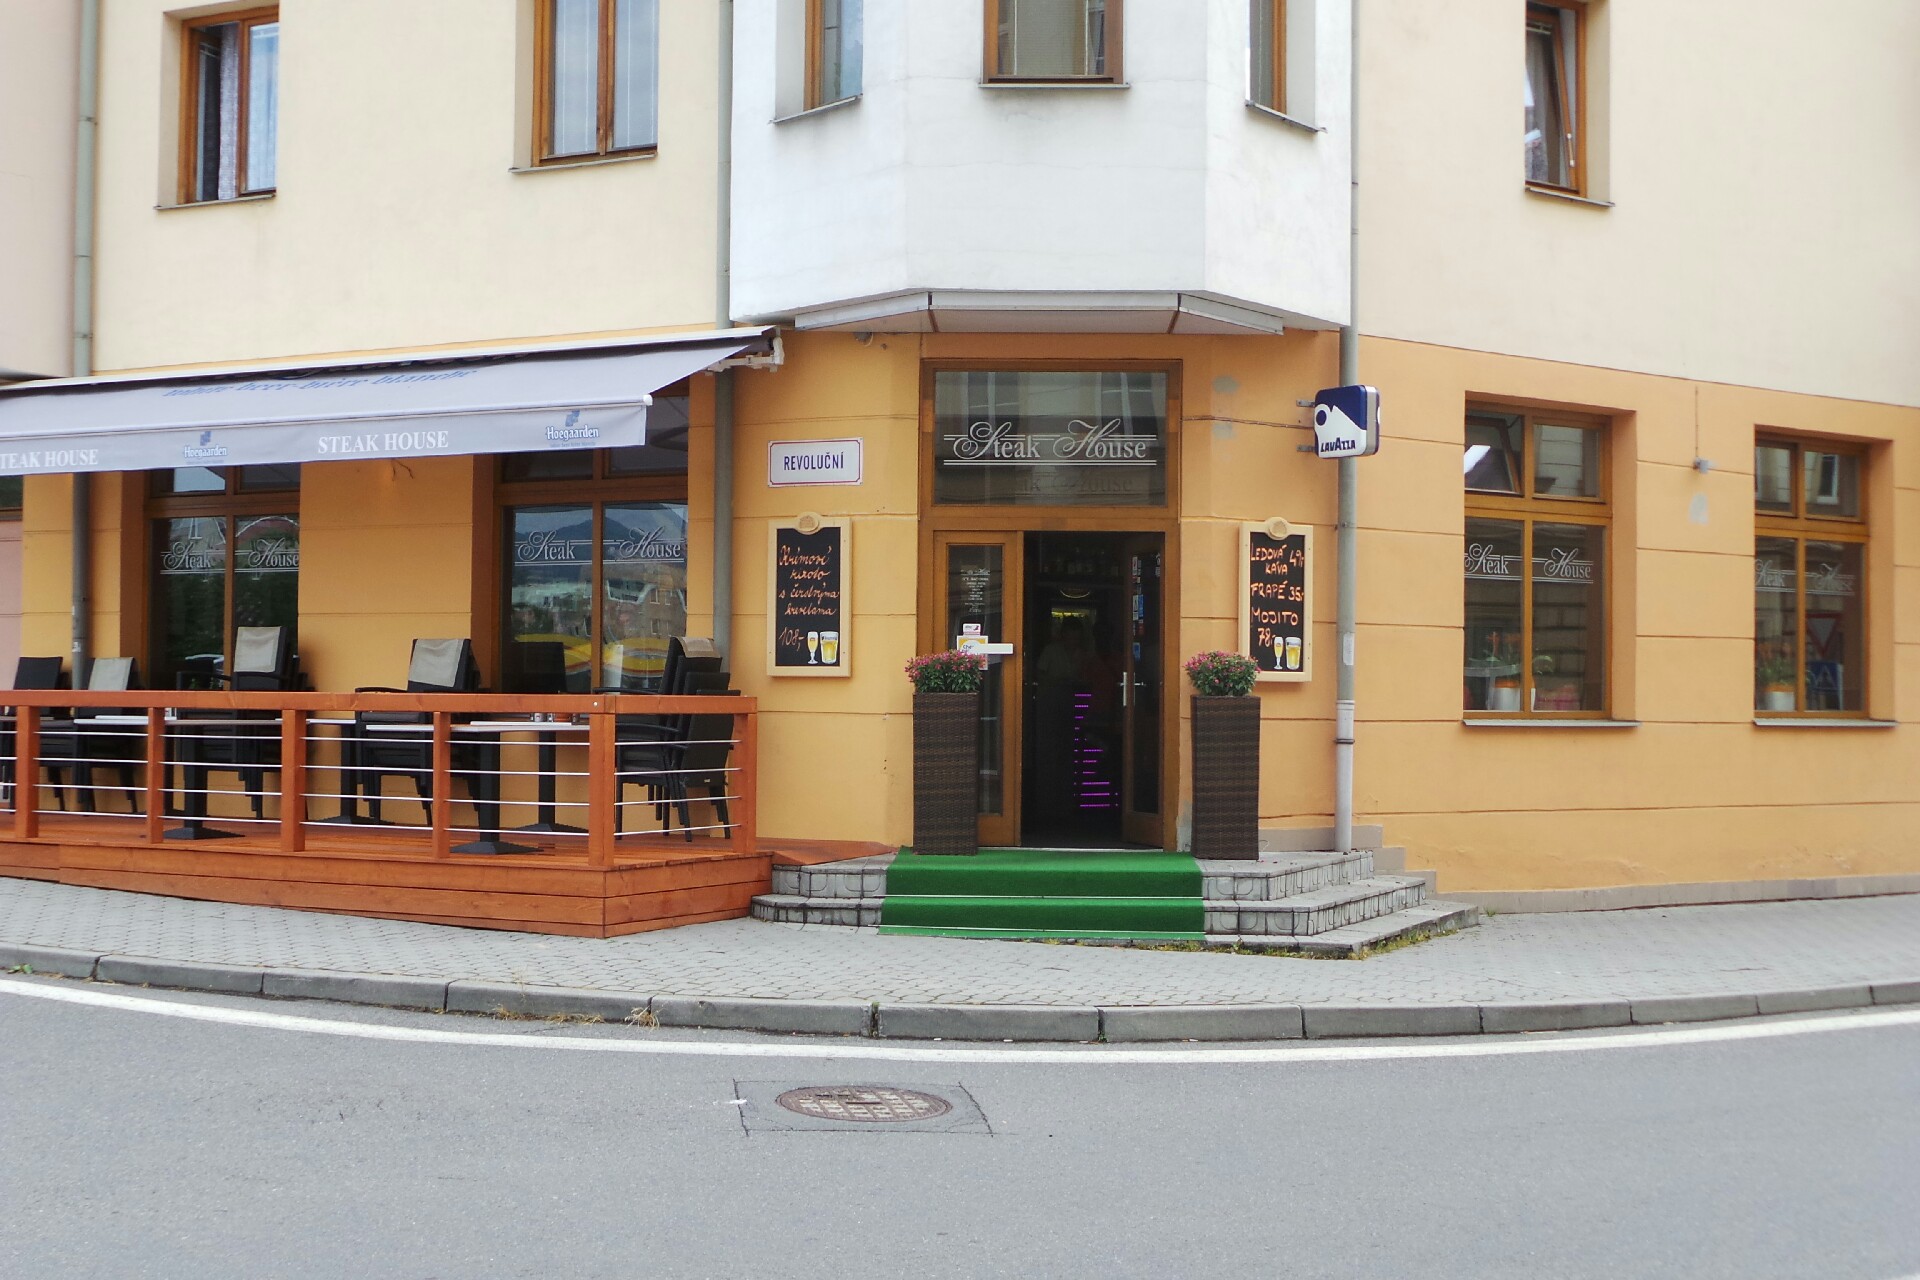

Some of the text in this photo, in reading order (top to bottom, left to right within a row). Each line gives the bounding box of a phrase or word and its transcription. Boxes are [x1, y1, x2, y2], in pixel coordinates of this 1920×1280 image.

[318, 430, 449, 454] STEAK HOUSE
[546, 424, 600, 441] Hoegaarden
[953, 418, 1147, 460] Steak House
[184, 443, 228, 459] Hoegaarden
[1320, 437, 1356, 453] LAVAZZA
[44, 449, 99, 468] HOUSE
[784, 451, 844, 471] REVOLUČNÍ
[163, 537, 300, 570] Steak House
[518, 526, 682, 562] Steak House
[1250, 542, 1288, 562] LEDOVÁ
[1265, 561, 1289, 576] KÁVA
[1464, 543, 1592, 579] Steak House
[1250, 580, 1289, 600] FRAPÉ
[1251, 607, 1299, 626] MOJITO
